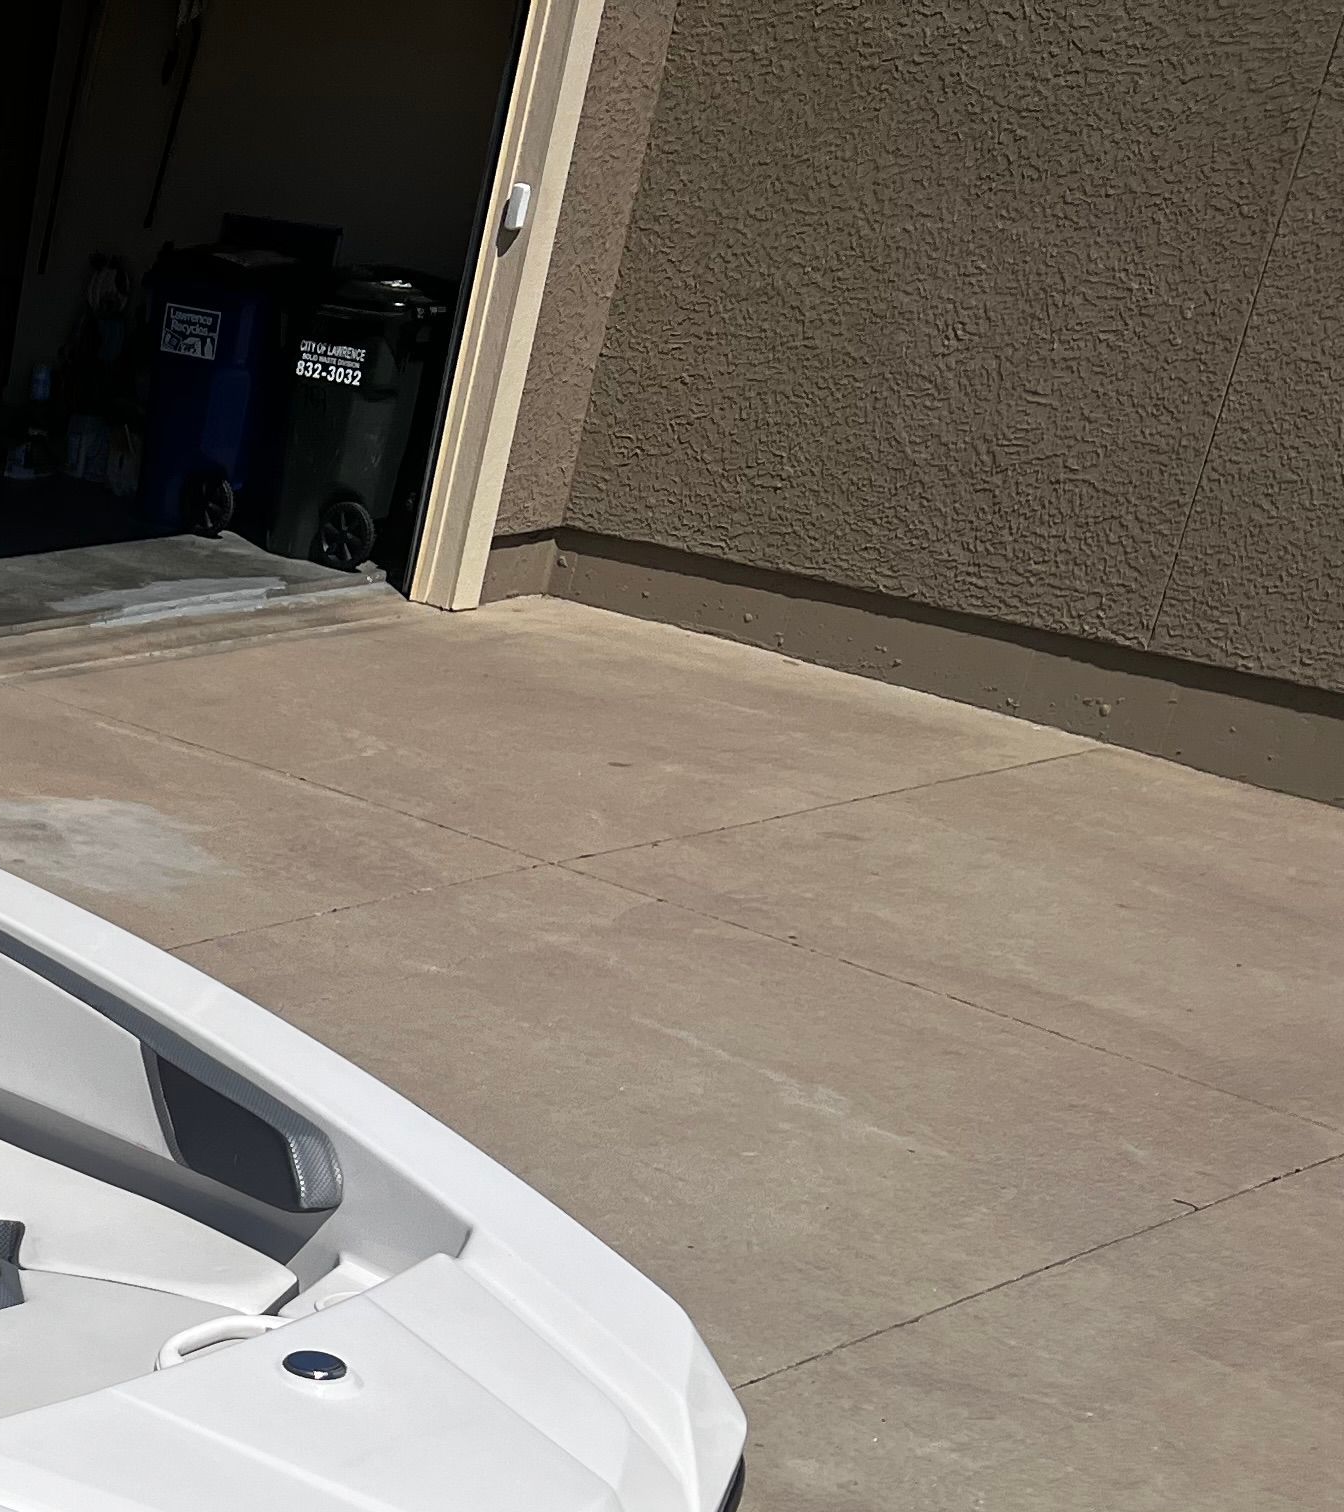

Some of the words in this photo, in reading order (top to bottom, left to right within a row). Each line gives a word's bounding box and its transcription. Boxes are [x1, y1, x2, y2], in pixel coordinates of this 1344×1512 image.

[300, 340, 316, 352] CITY
[317, 342, 327, 354] OF
[327, 344, 366, 361] LAWRENCE
[296, 361, 362, 386] 832-3032
